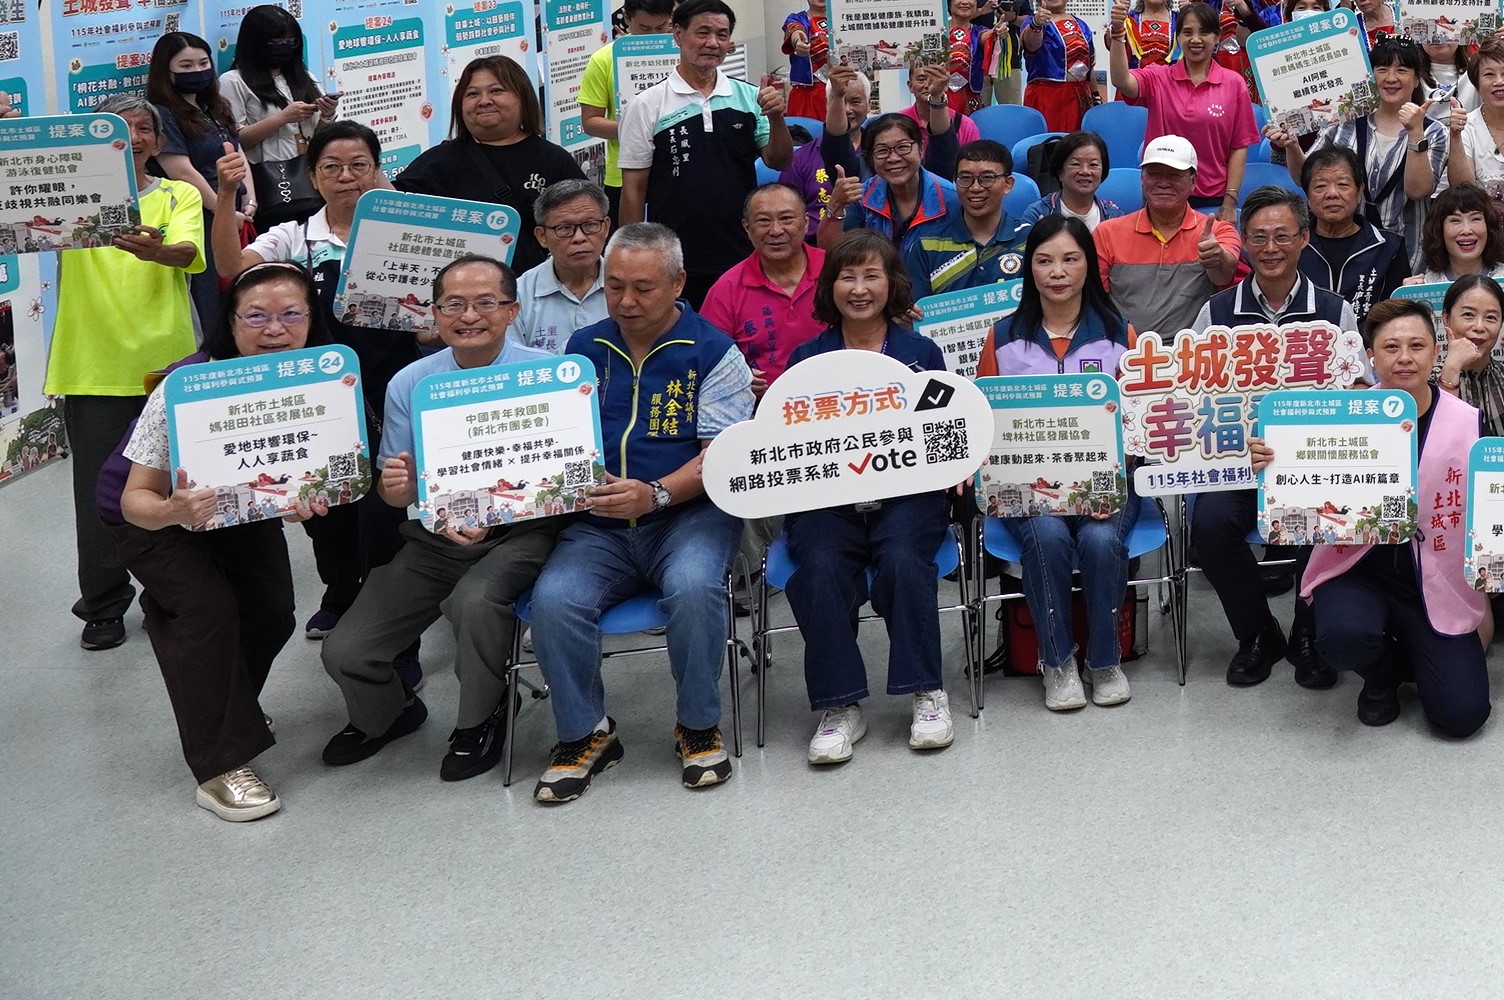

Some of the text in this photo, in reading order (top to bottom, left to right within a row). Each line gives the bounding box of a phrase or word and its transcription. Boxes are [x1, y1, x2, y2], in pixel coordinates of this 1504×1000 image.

[1308, 17, 1345, 35] 提案 21
[1284, 43, 1331, 62] 新北市土城區
[49, 124, 110, 139] 提案 13
[451, 208, 505, 225] 提案 16
[402, 232, 467, 248] 新北市土城區
[983, 291, 1009, 305] 提案
[277, 357, 340, 378] 提案 24
[1123, 328, 1334, 394] 土城發聲
[183, 364, 269, 383] 115年度新北市土城區
[430, 374, 510, 390] 115年度新北市土城區
[517, 366, 576, 386] 提案 11
[686, 370, 697, 424] 新北市議員
[1053, 383, 1102, 397] 提案 2
[228, 394, 306, 416] 新北市土城區
[466, 402, 549, 424] 中國青年救國團
[662, 380, 683, 435] 林金結
[782, 382, 905, 426] 投票方式
[1348, 400, 1399, 415] 提案 7
[209, 405, 326, 433] 媽祖田社區發展協會
[468, 418, 549, 439] (新北市團委會)
[1012, 418, 1079, 428] 新北市土城區
[223, 431, 318, 456] 愛地球響環保~
[1002, 430, 1090, 442] 埤林社區發展協會
[1307, 437, 1369, 447] 新北市土城區
[750, 428, 914, 466] 新北市政府公民參與
[1296, 449, 1379, 460] 鄉親關懷服務協會
[238, 448, 309, 470] 人人享蔬食
[437, 459, 503, 477] 學習社會情緒
[520, 447, 584, 464] 提升幸福關係
[729, 462, 840, 494] 網路投票系統
[1276, 473, 1400, 485] 創心人生~打造AI新篇章
[1446, 467, 1462, 528] 新北市
[1431, 492, 1447, 552] 土城區
